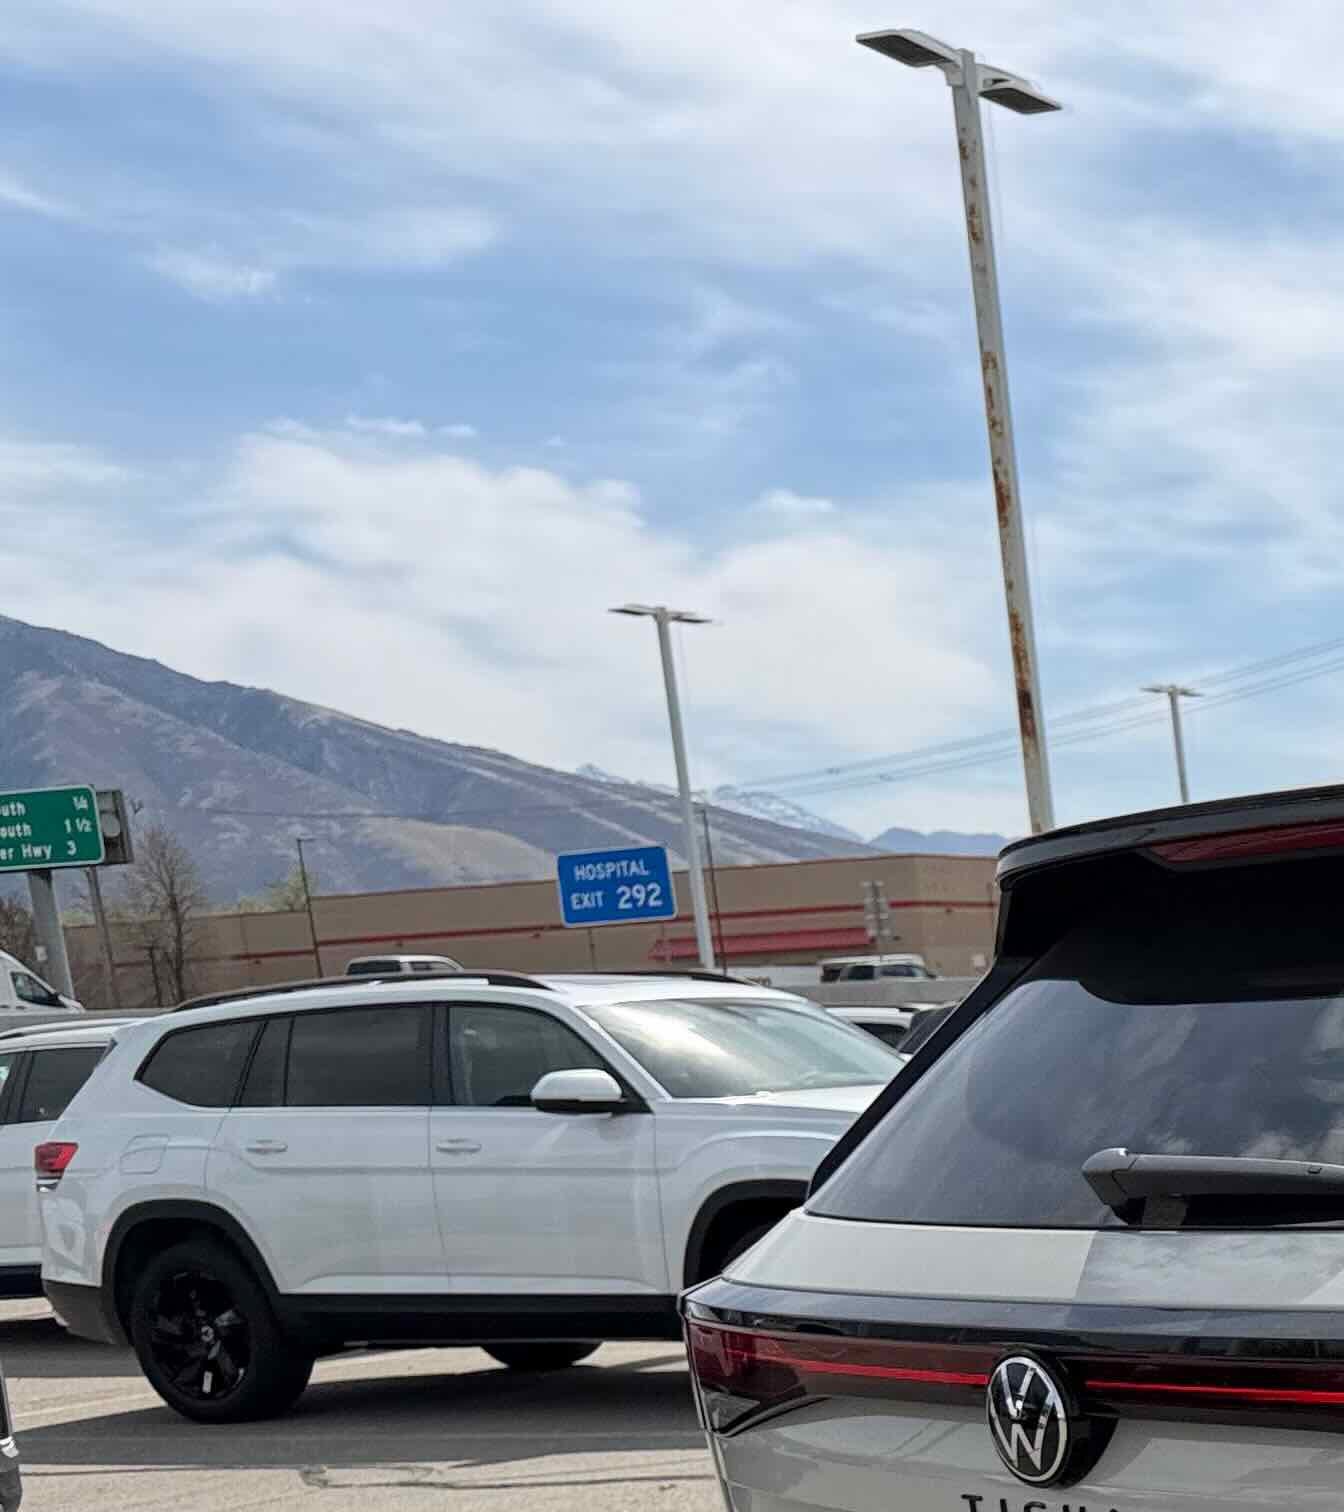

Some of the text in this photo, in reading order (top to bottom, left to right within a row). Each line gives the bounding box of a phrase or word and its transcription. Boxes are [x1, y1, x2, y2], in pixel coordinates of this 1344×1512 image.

[0, 801, 26, 816] uth
[21, 843, 52, 860] Hwy
[67, 840, 77, 855] 3
[574, 859, 650, 880] HOSPITAL
[570, 882, 663, 910] EXIT 292
